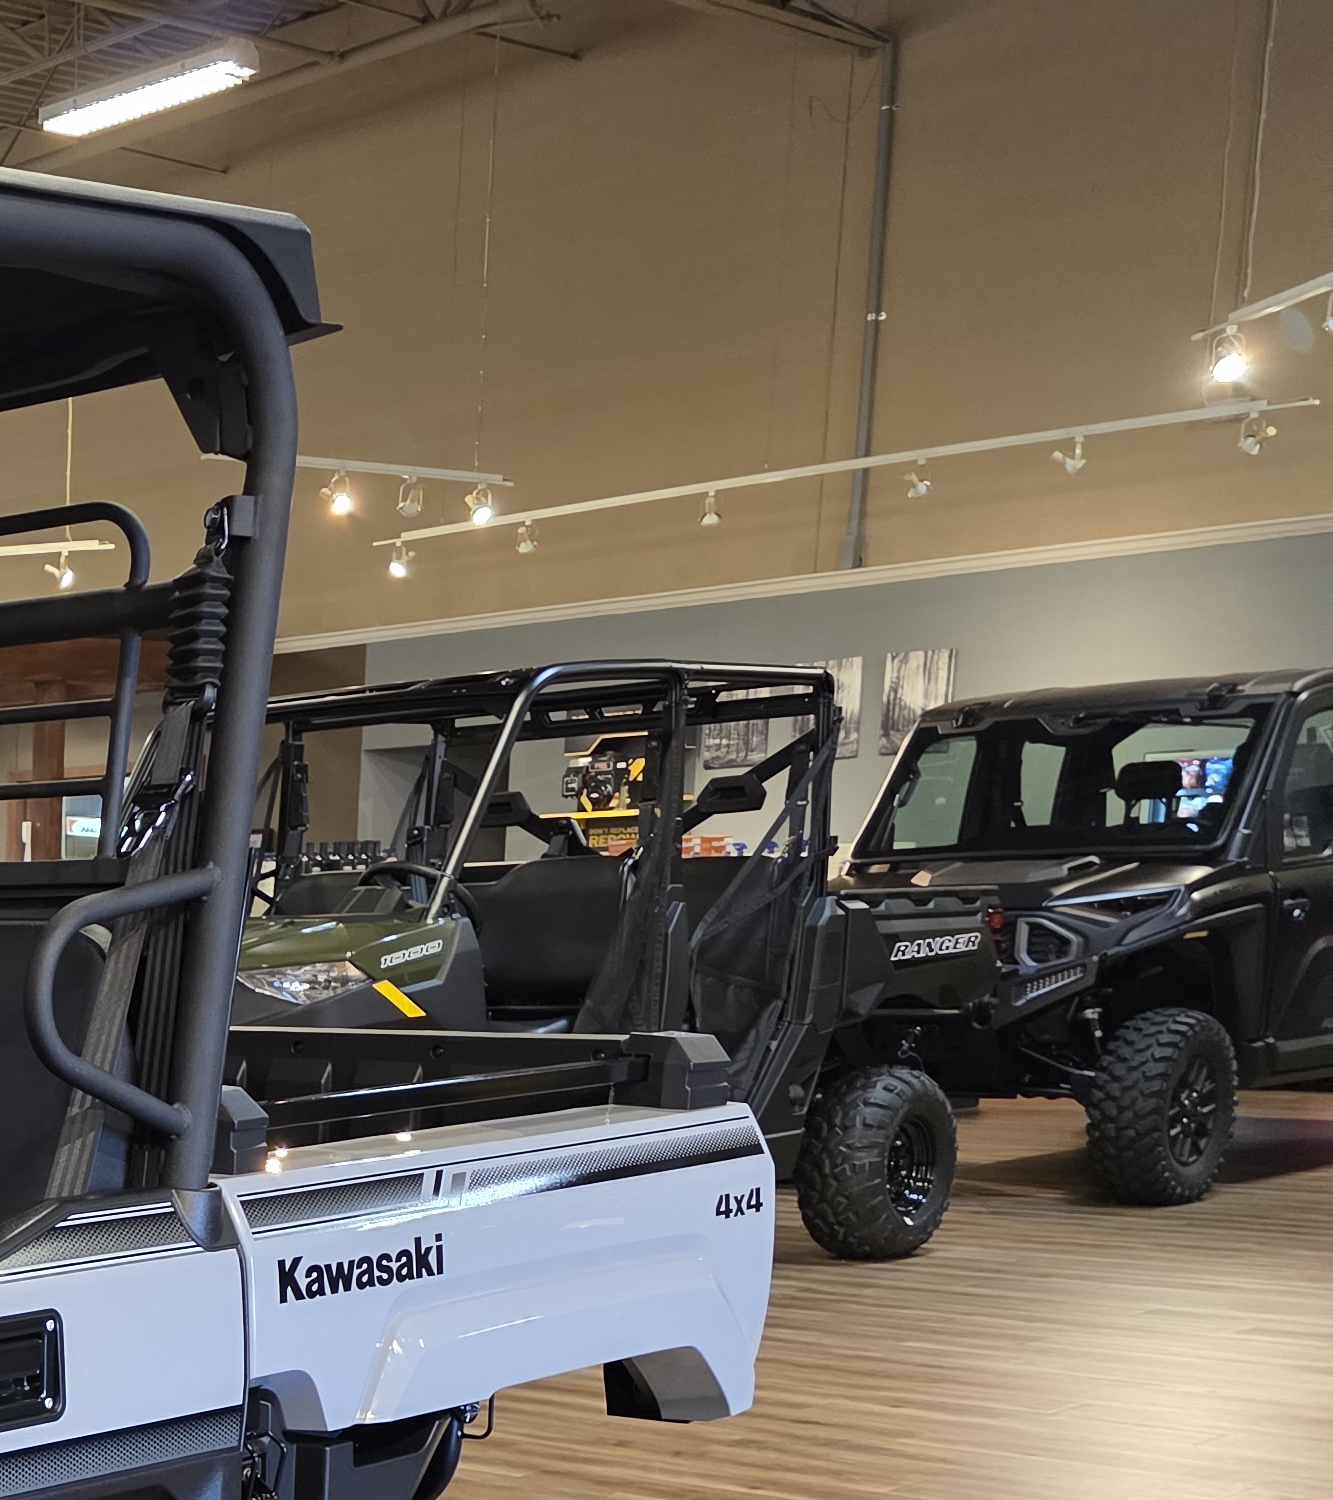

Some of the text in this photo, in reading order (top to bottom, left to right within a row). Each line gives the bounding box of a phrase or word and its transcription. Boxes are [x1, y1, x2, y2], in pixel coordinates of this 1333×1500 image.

[380, 939, 443, 969] 1000
[890, 932, 982, 961] RANGER
[715, 1186, 764, 1220] 4x4
[277, 1233, 445, 1304] Kawasaki
